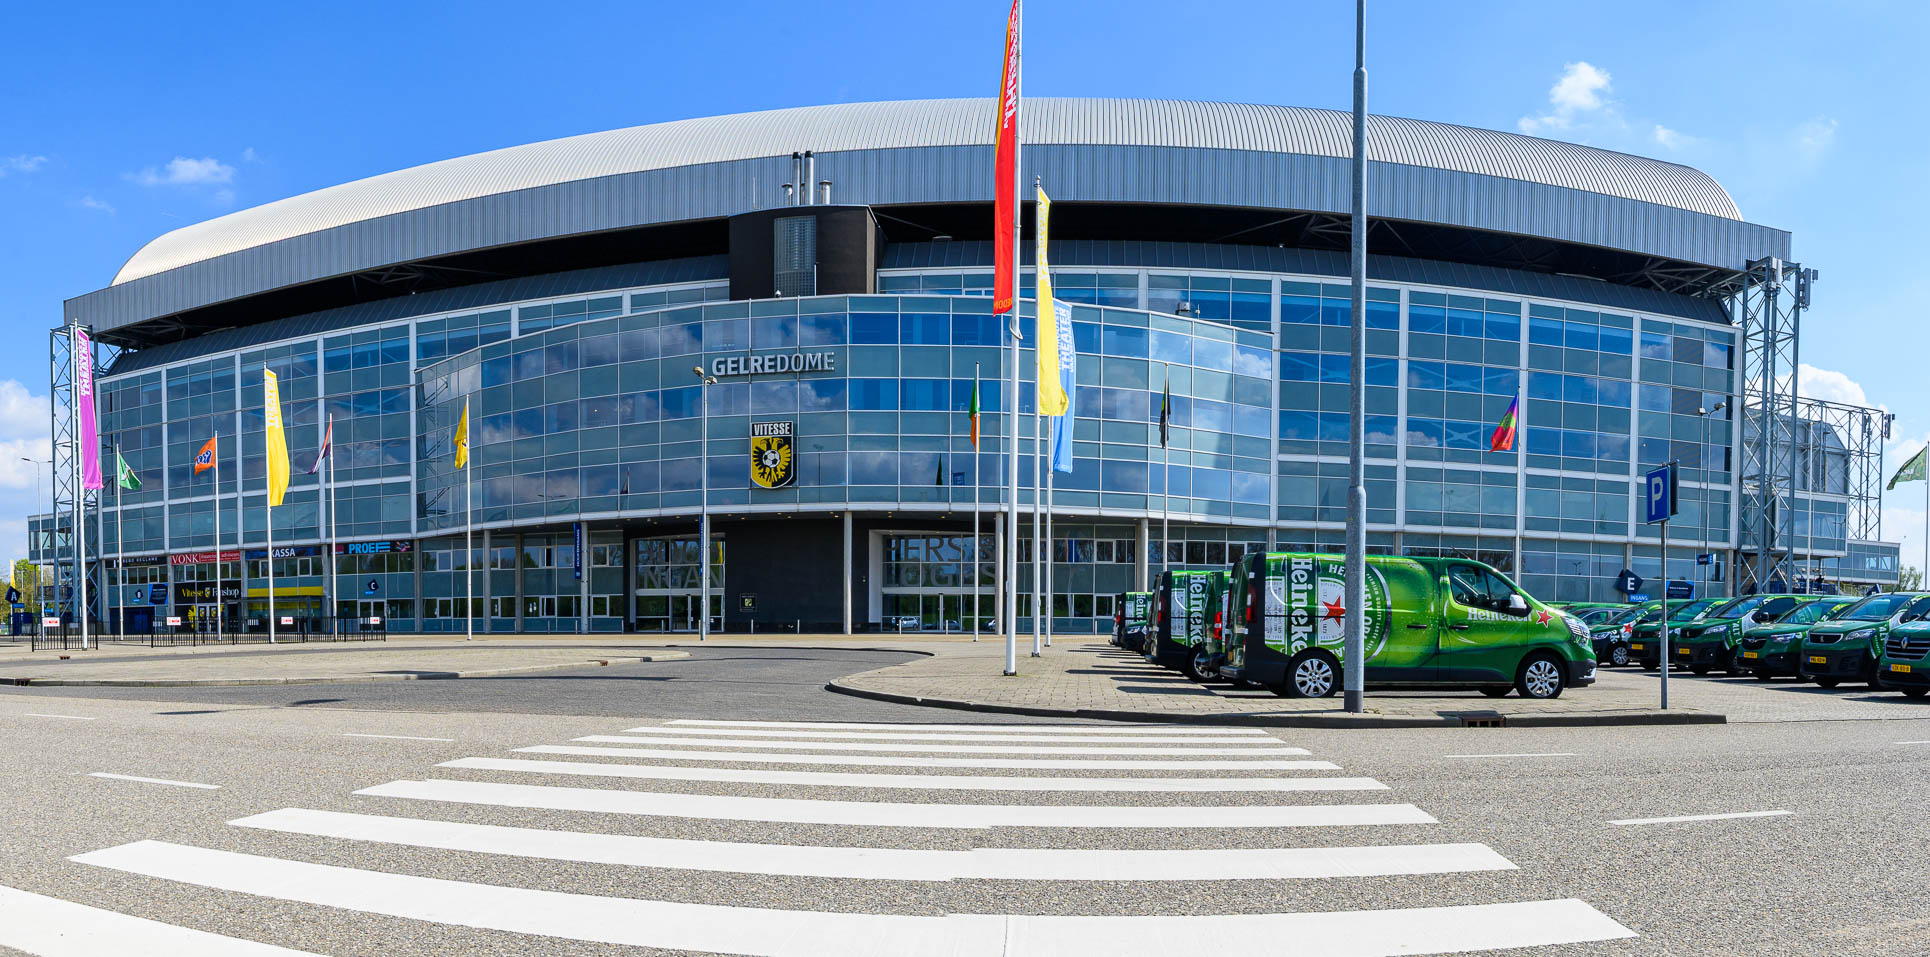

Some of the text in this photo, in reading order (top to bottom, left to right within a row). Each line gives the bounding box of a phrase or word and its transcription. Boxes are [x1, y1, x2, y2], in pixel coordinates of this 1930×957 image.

[711, 352, 835, 376] GELREDOME
[754, 422, 790, 436] VITESSE
[1651, 476, 1663, 516] P
[171, 554, 199, 564] VONK
[181, 587, 204, 598] Vitesse
[1627, 577, 1635, 591] E
[1190, 574, 1206, 648] Heineke
[1290, 557, 1314, 657] Heineke
